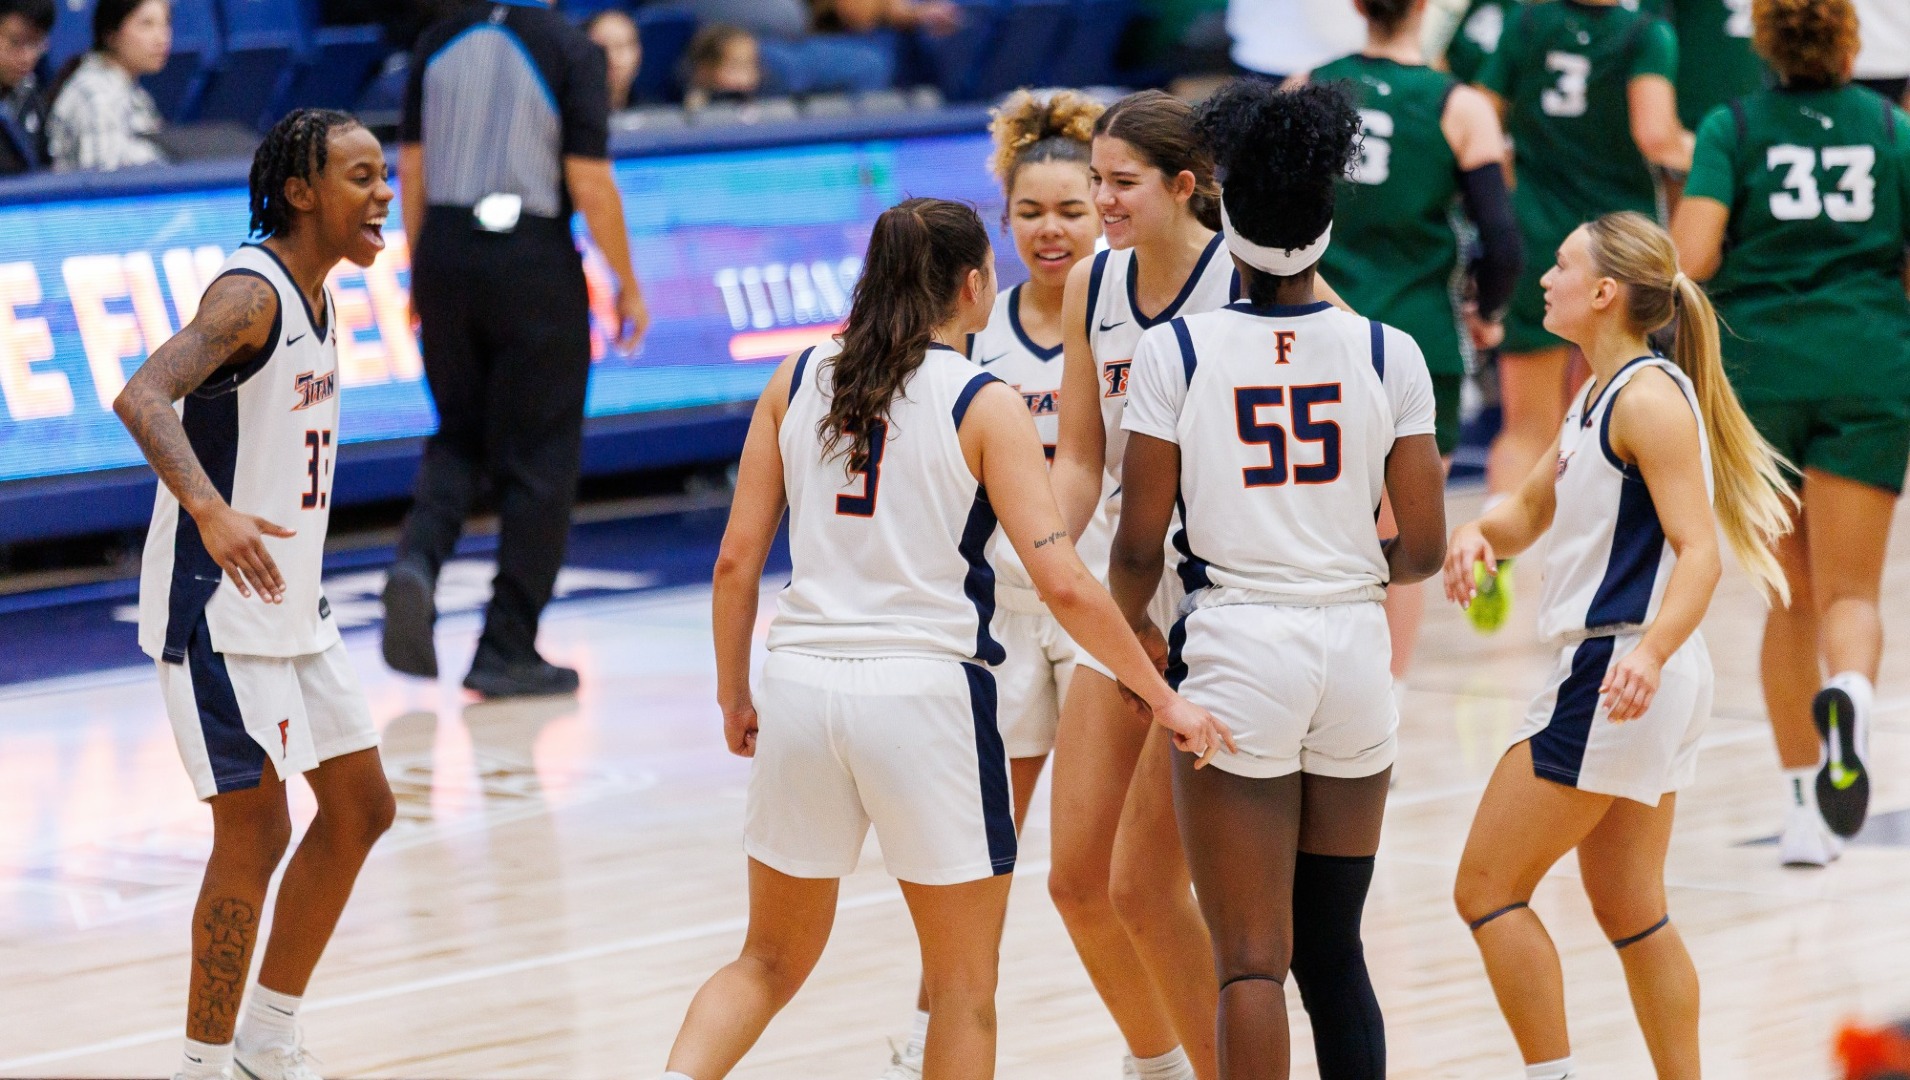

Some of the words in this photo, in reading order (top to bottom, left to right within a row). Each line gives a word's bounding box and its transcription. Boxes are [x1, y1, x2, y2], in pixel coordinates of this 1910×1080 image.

[1541, 50, 1591, 118] 3
[1767, 144, 1876, 222] 33
[1273, 331, 1296, 365] F
[835, 415, 888, 518] 3
[1233, 382, 1342, 489] 55
